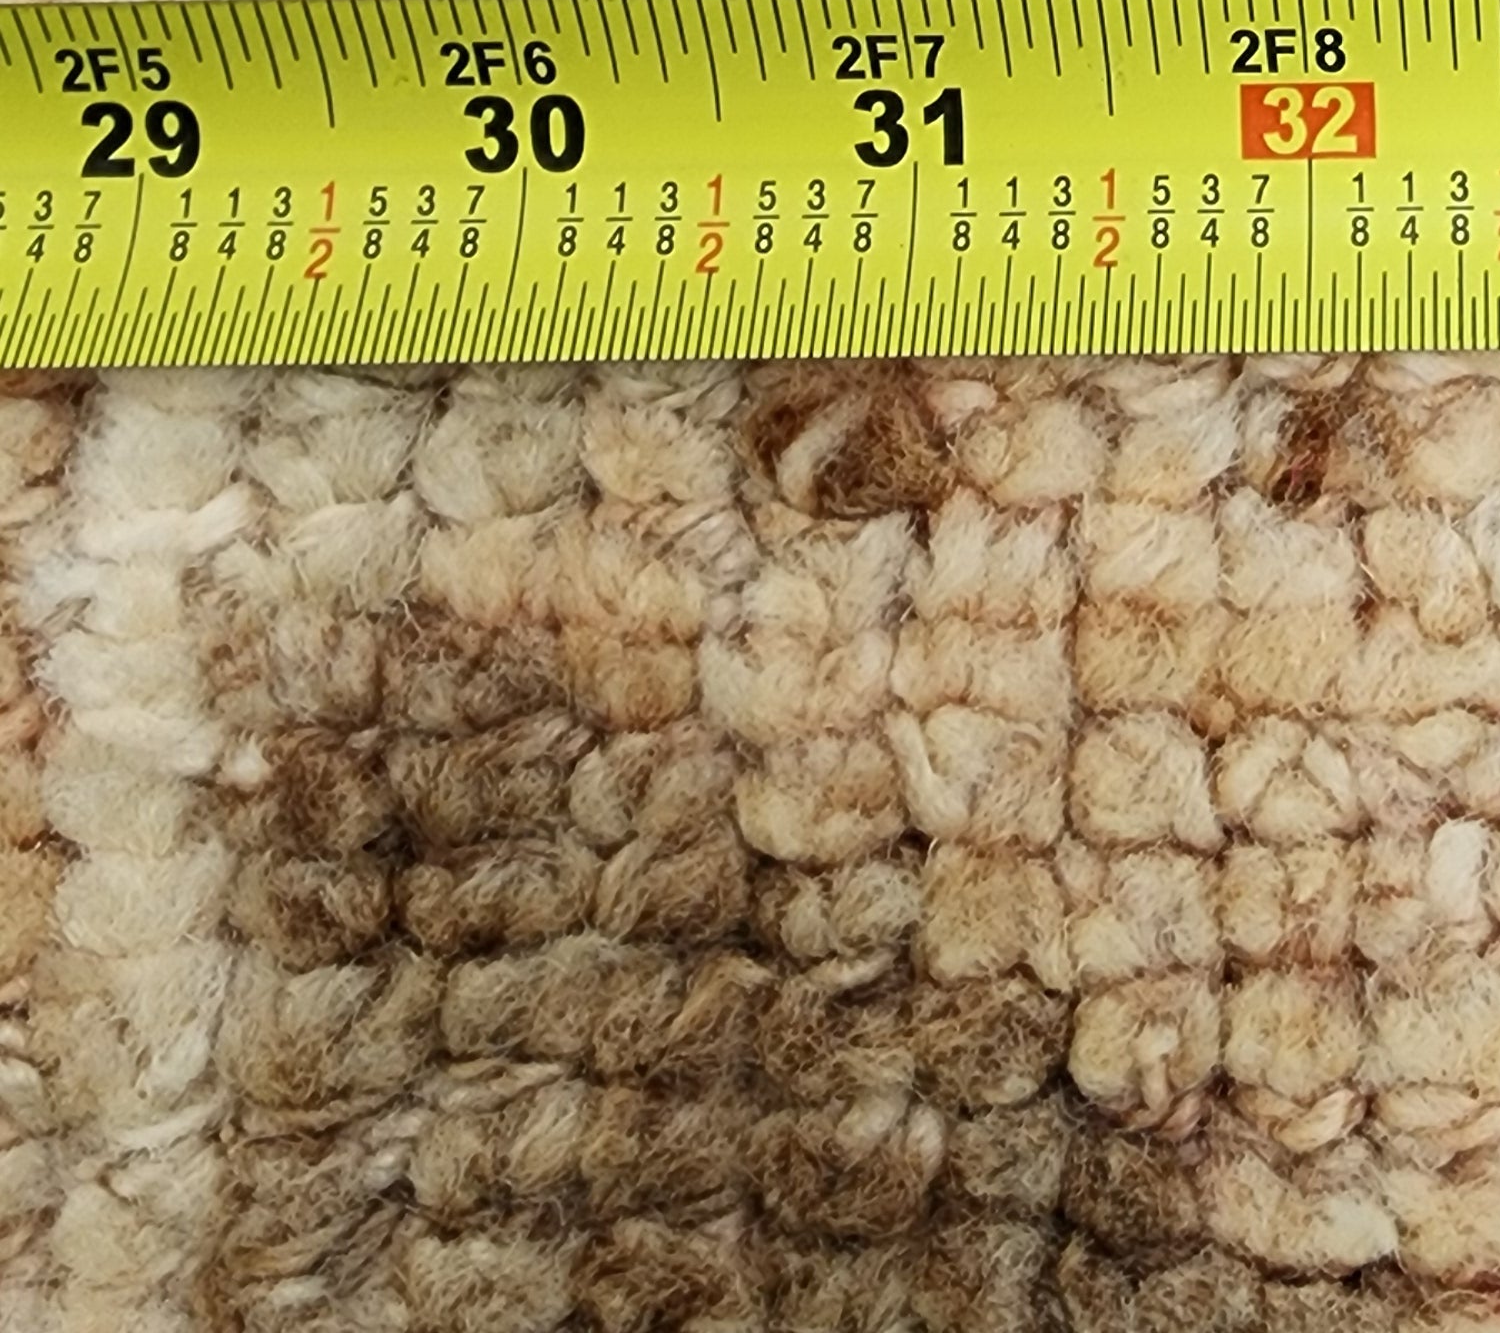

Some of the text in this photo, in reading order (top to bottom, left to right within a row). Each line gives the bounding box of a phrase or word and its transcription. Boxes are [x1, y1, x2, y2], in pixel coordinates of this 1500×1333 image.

[81, 101, 201, 178] 29
[465, 95, 585, 172] 30
[854, 88, 964, 167] 31
[1262, 87, 1357, 155] 32
